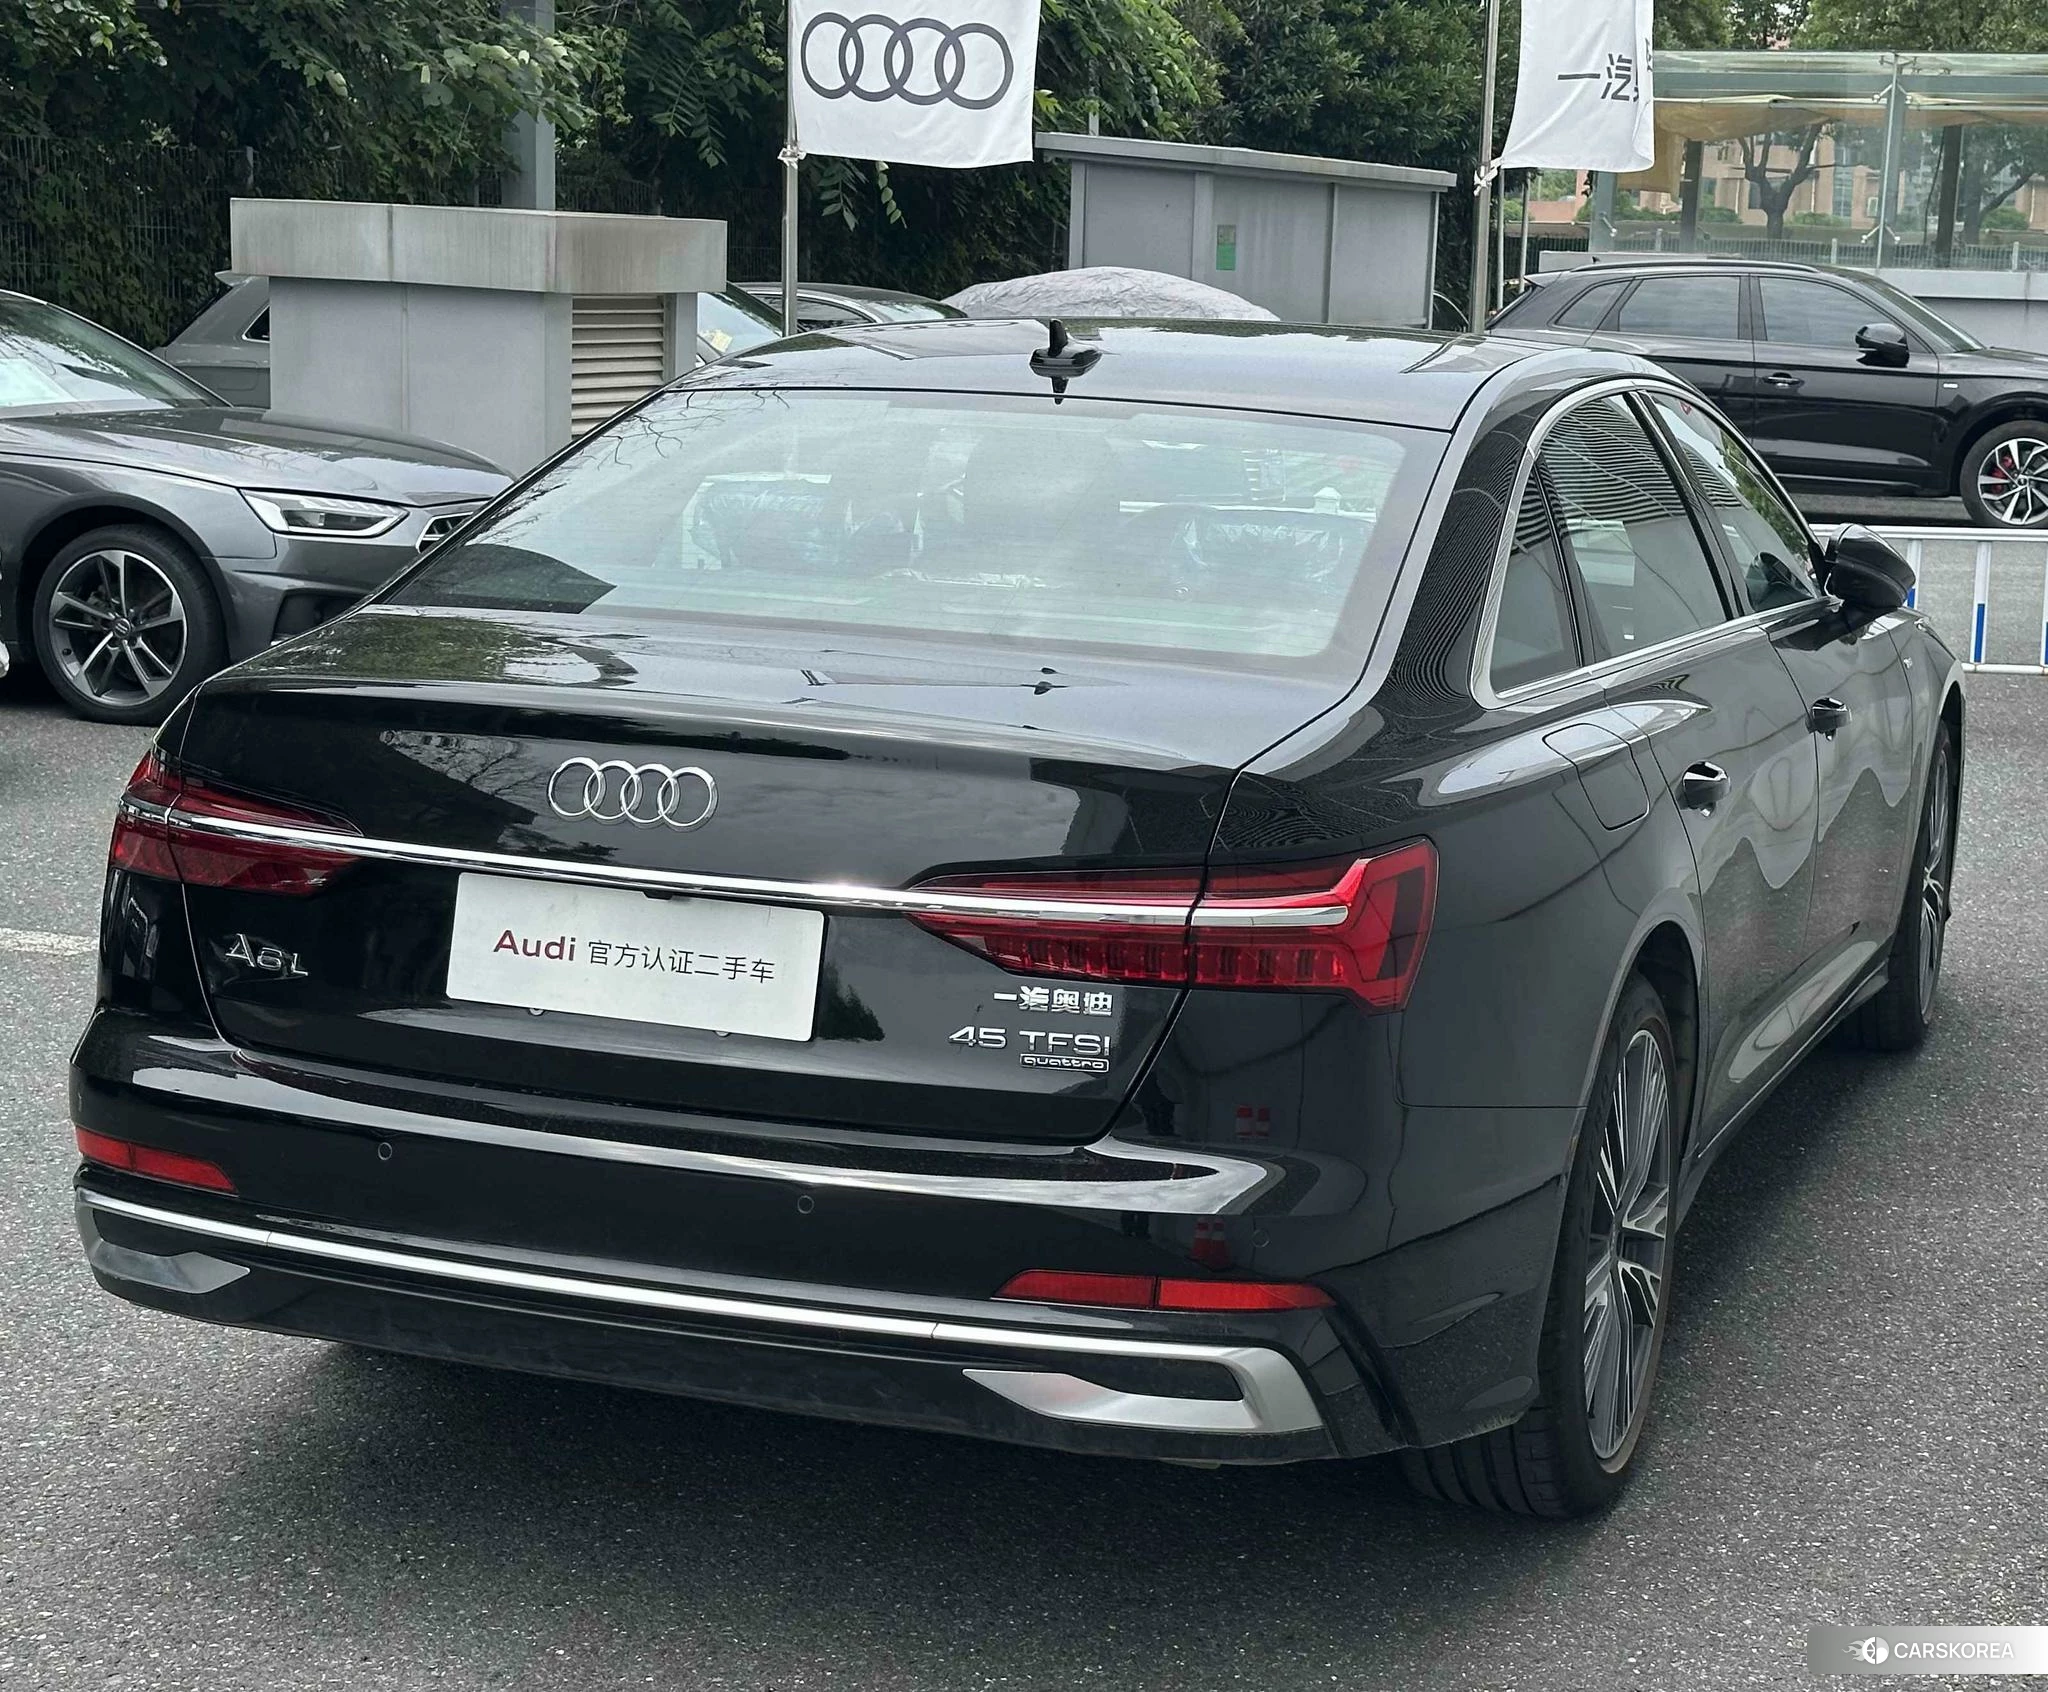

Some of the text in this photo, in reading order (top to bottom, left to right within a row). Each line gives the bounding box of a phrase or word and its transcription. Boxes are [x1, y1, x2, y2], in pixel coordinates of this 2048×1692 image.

[225, 933, 309, 977] A6L
[493, 929, 775, 985] Audi 官方认证二手车
[993, 985, 1113, 1017] 一汽奥迪
[948, 1025, 1111, 1057] 45 TFSI
[1023, 1055, 1105, 1070] quattro
